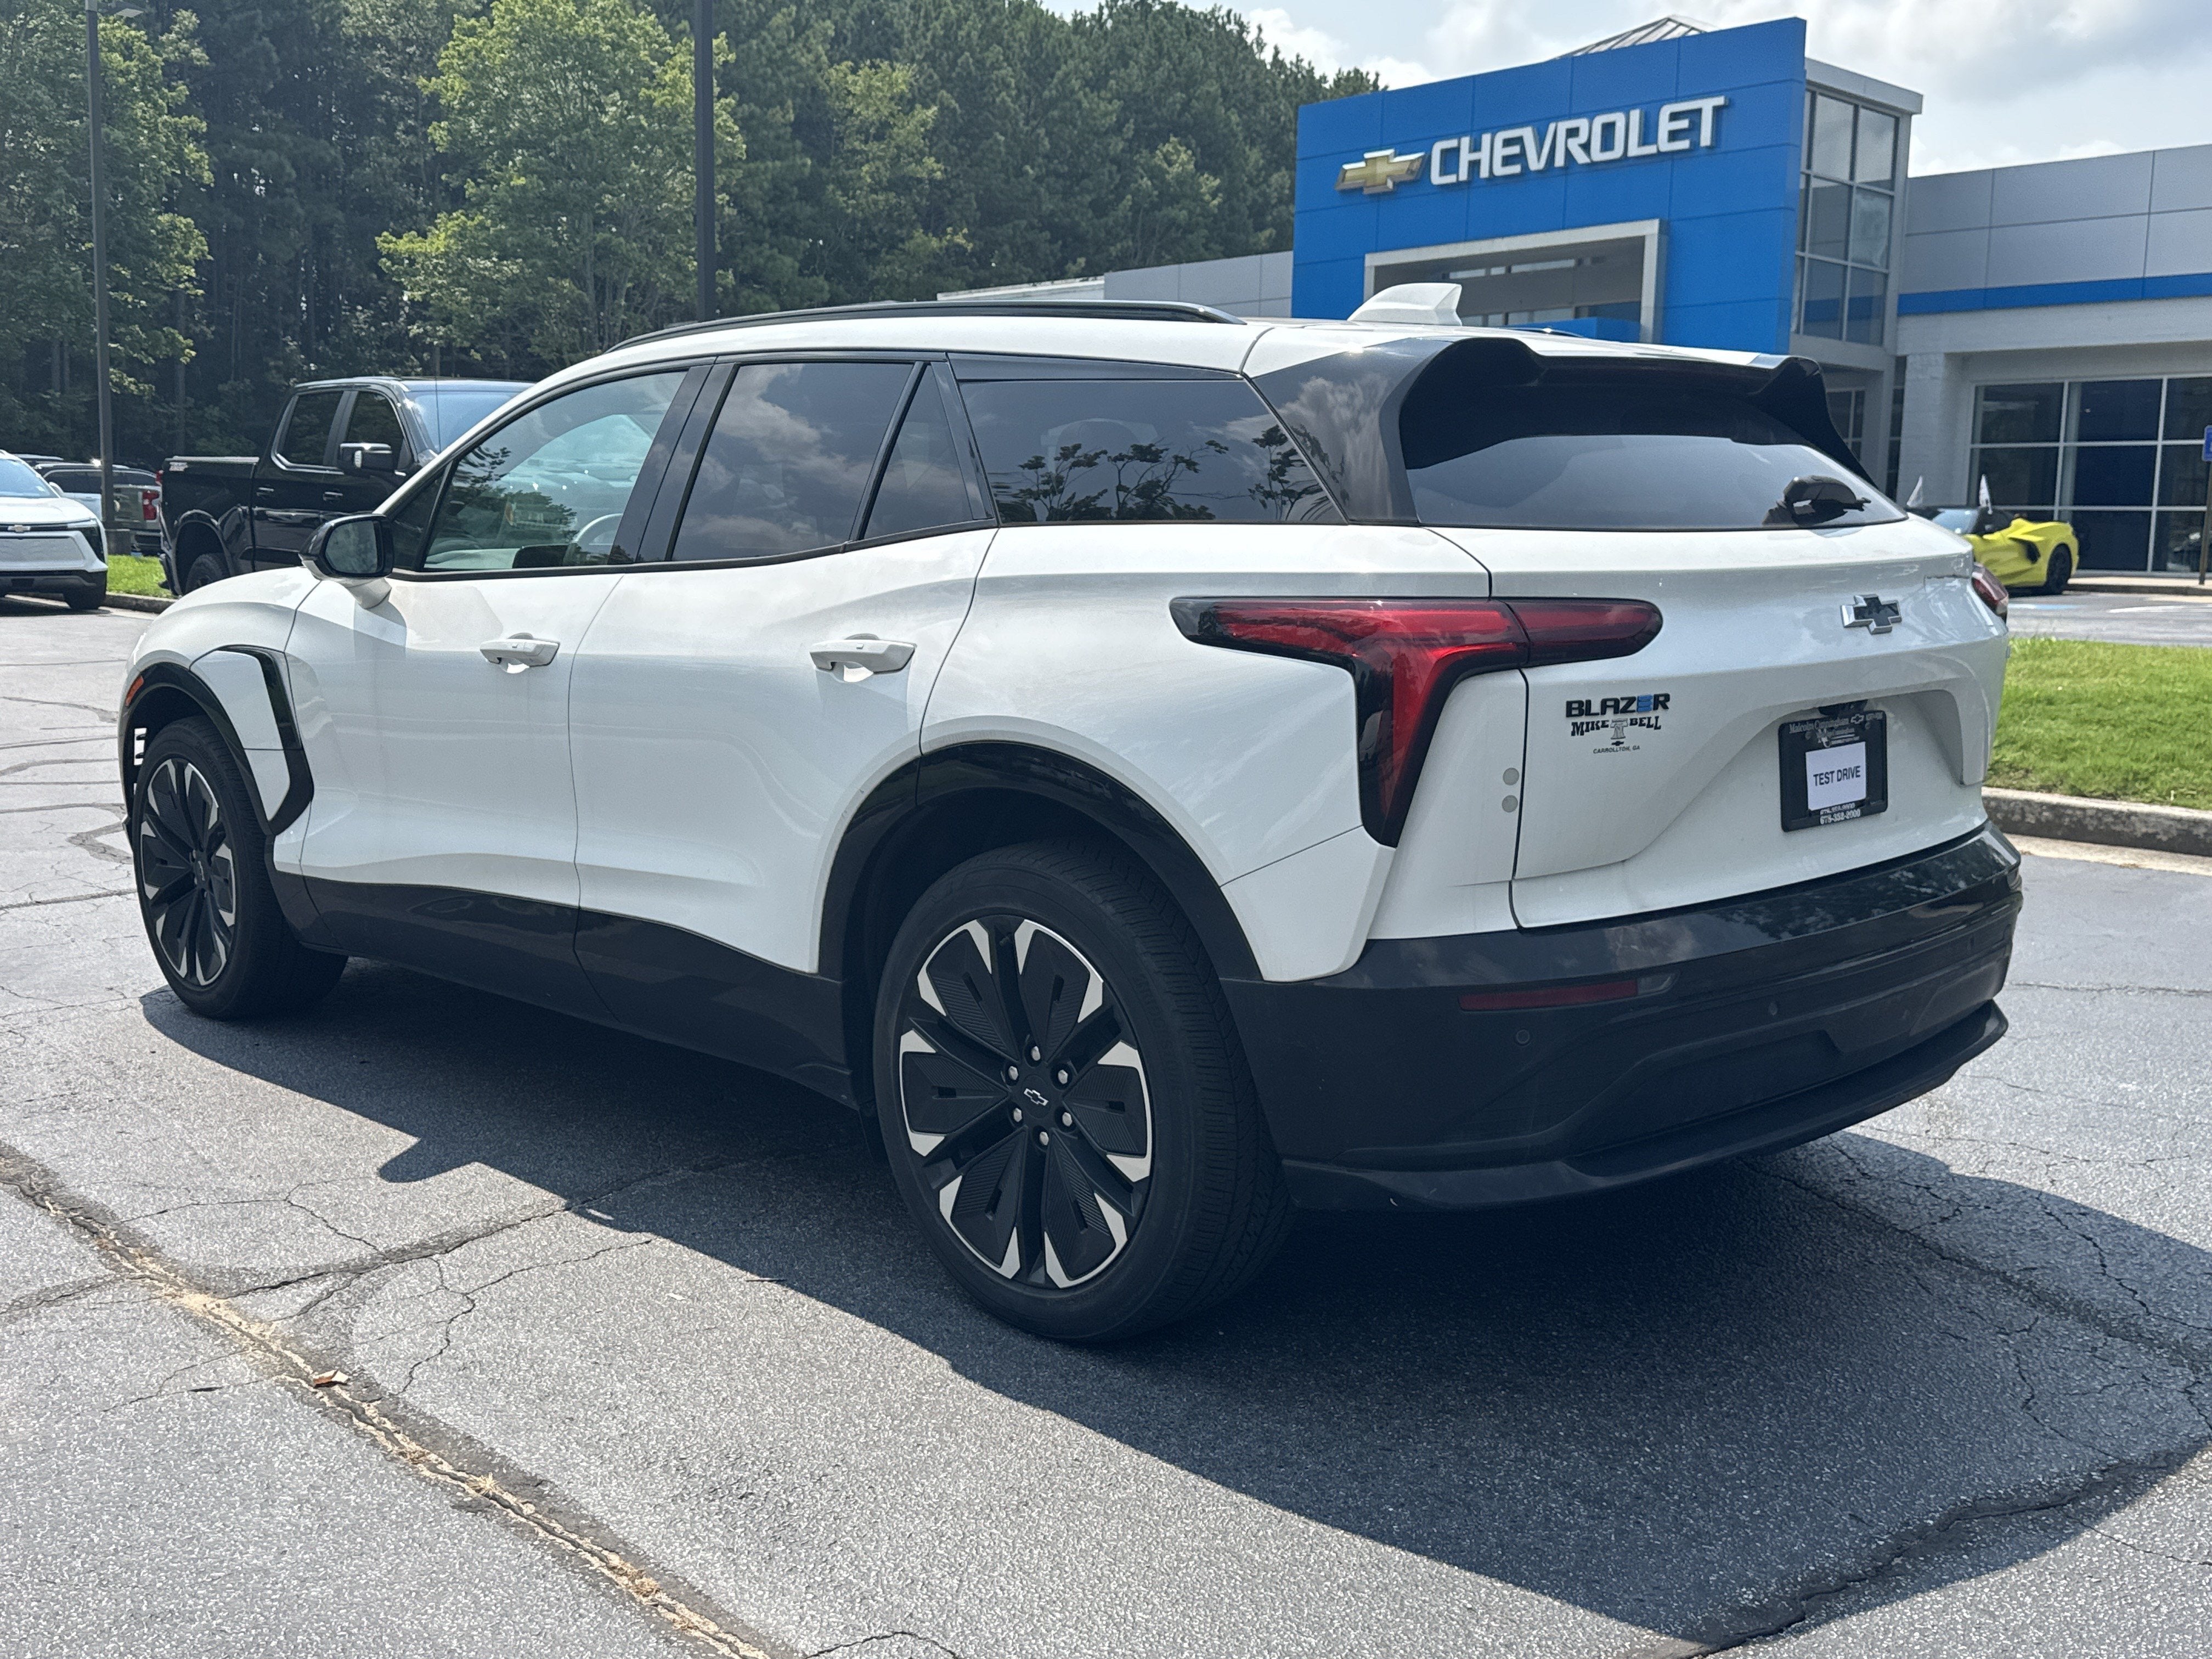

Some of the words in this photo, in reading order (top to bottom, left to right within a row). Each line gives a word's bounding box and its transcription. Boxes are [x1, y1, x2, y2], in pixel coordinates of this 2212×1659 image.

[1430, 95, 1728, 186] CHEVROLET
[1566, 693, 1671, 718] BLAZER
[1571, 720, 1610, 737] MIKE
[1629, 715, 1662, 730] BELL
[1813, 770, 1835, 786] TEST
[1837, 765, 1861, 782] DRIVE
